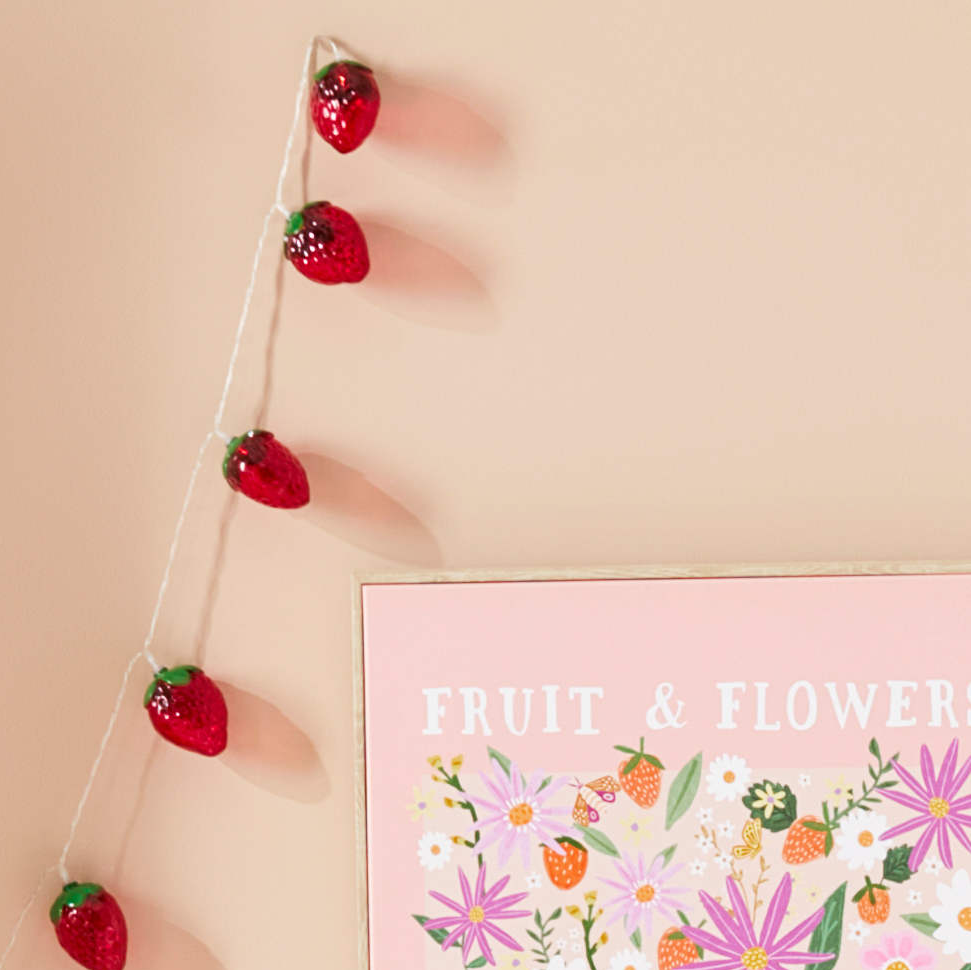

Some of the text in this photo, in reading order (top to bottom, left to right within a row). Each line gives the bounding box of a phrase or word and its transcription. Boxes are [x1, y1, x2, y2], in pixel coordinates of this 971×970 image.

[421, 679, 971, 736] FRUIT & FLOWER
